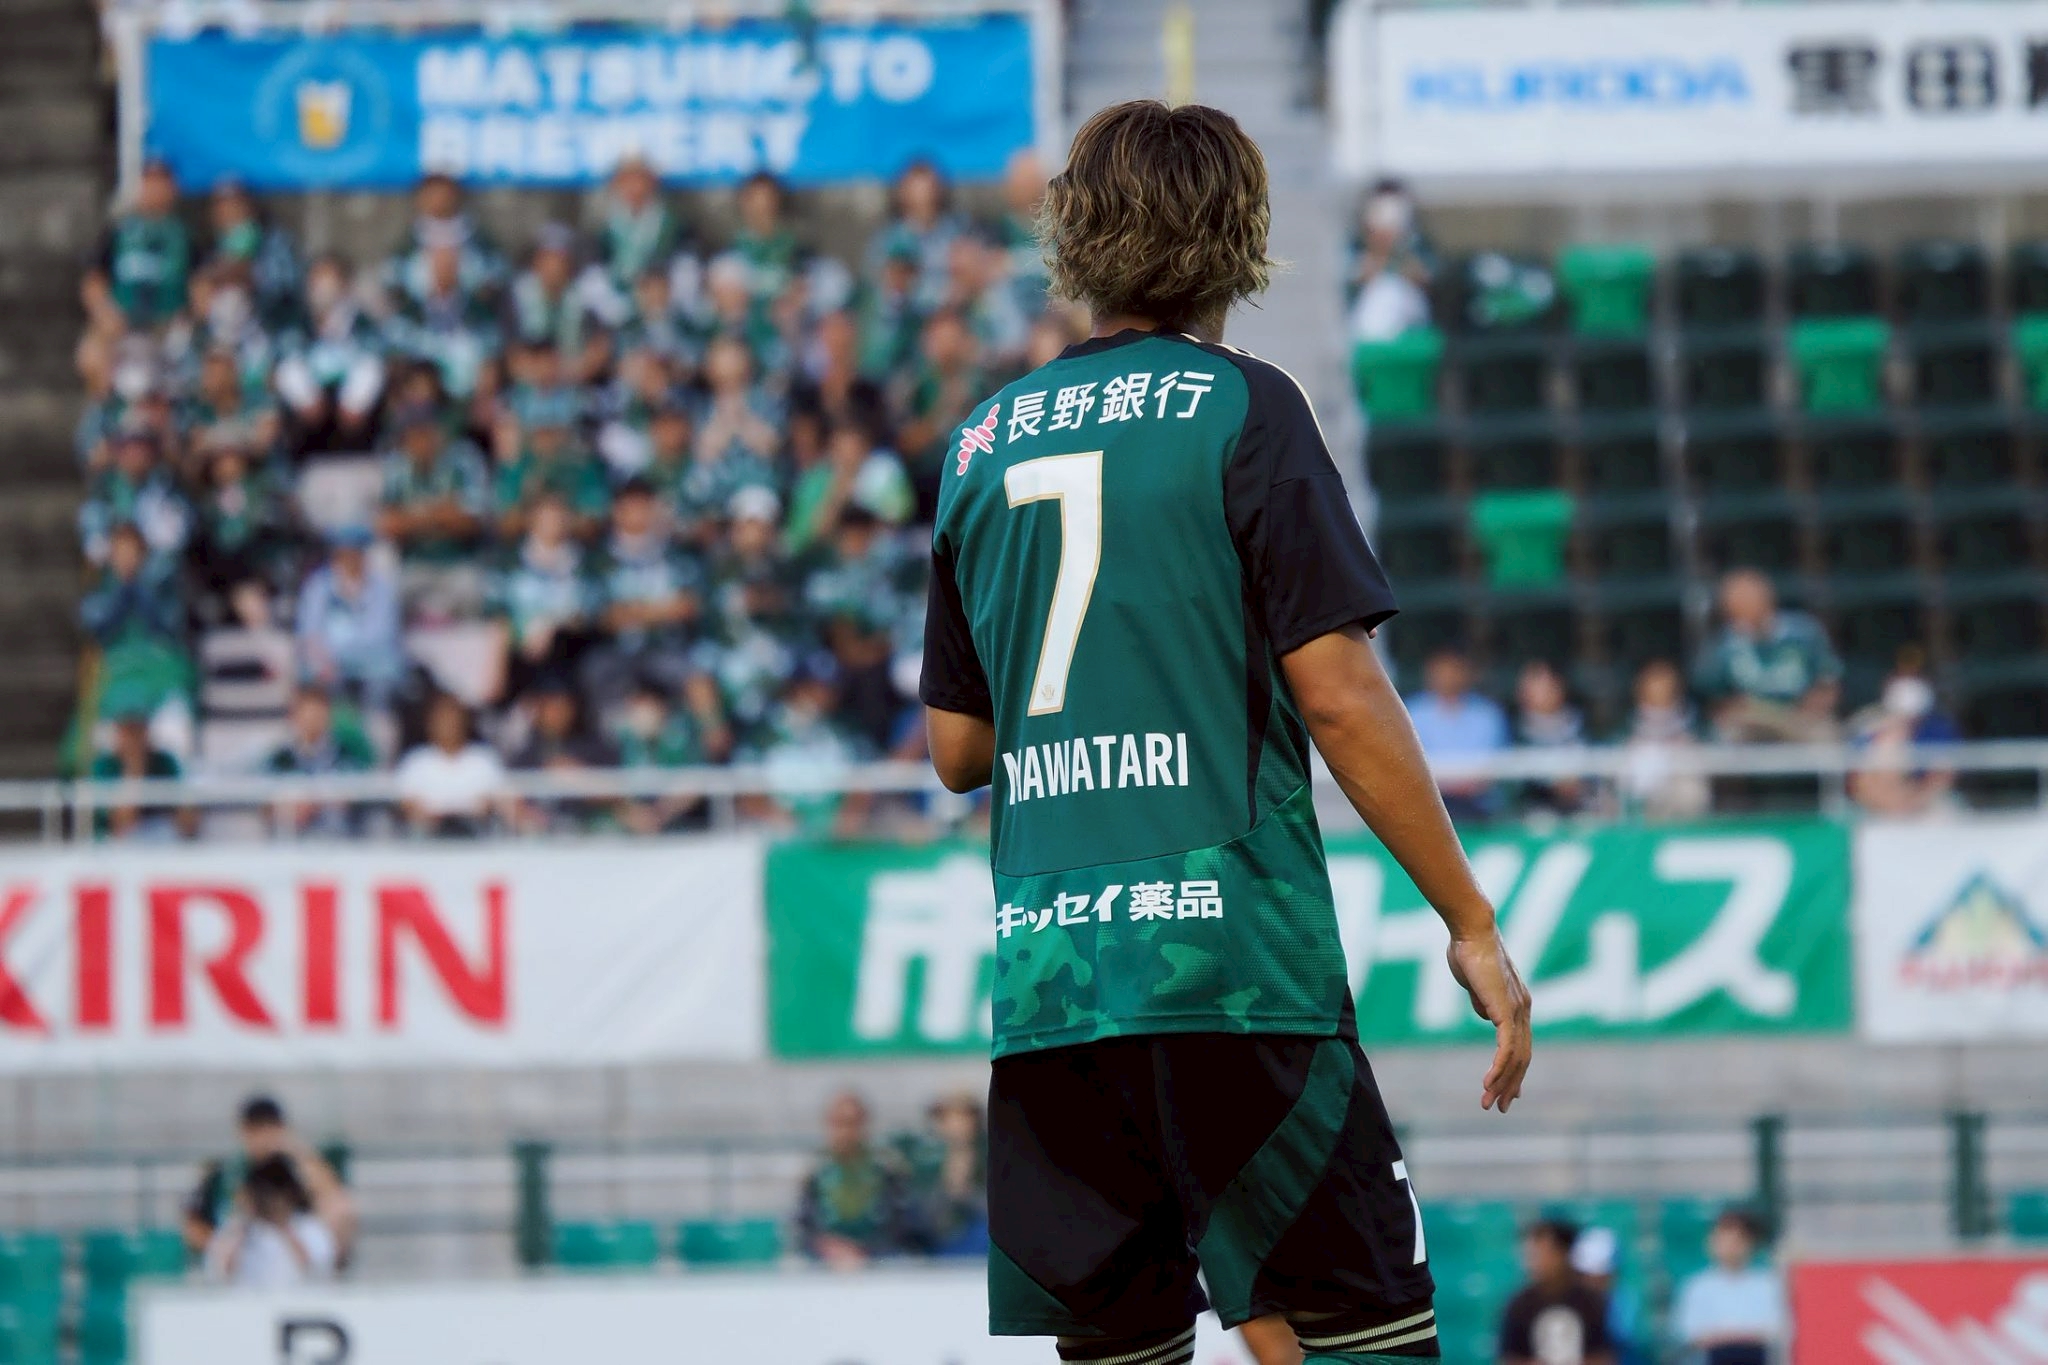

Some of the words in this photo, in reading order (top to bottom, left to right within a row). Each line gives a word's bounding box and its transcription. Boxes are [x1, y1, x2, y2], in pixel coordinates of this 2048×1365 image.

[417, 36, 934, 105] MATSUMOTO
[1785, 40, 2048, 117] 黒田
[419, 112, 806, 176] BREWERY
[1006, 370, 1216, 445] 長野銀行
[1004, 450, 1104, 717] 7
[1002, 732, 1190, 806] NAWATARI
[995, 879, 1223, 938] キッセイ薬品
